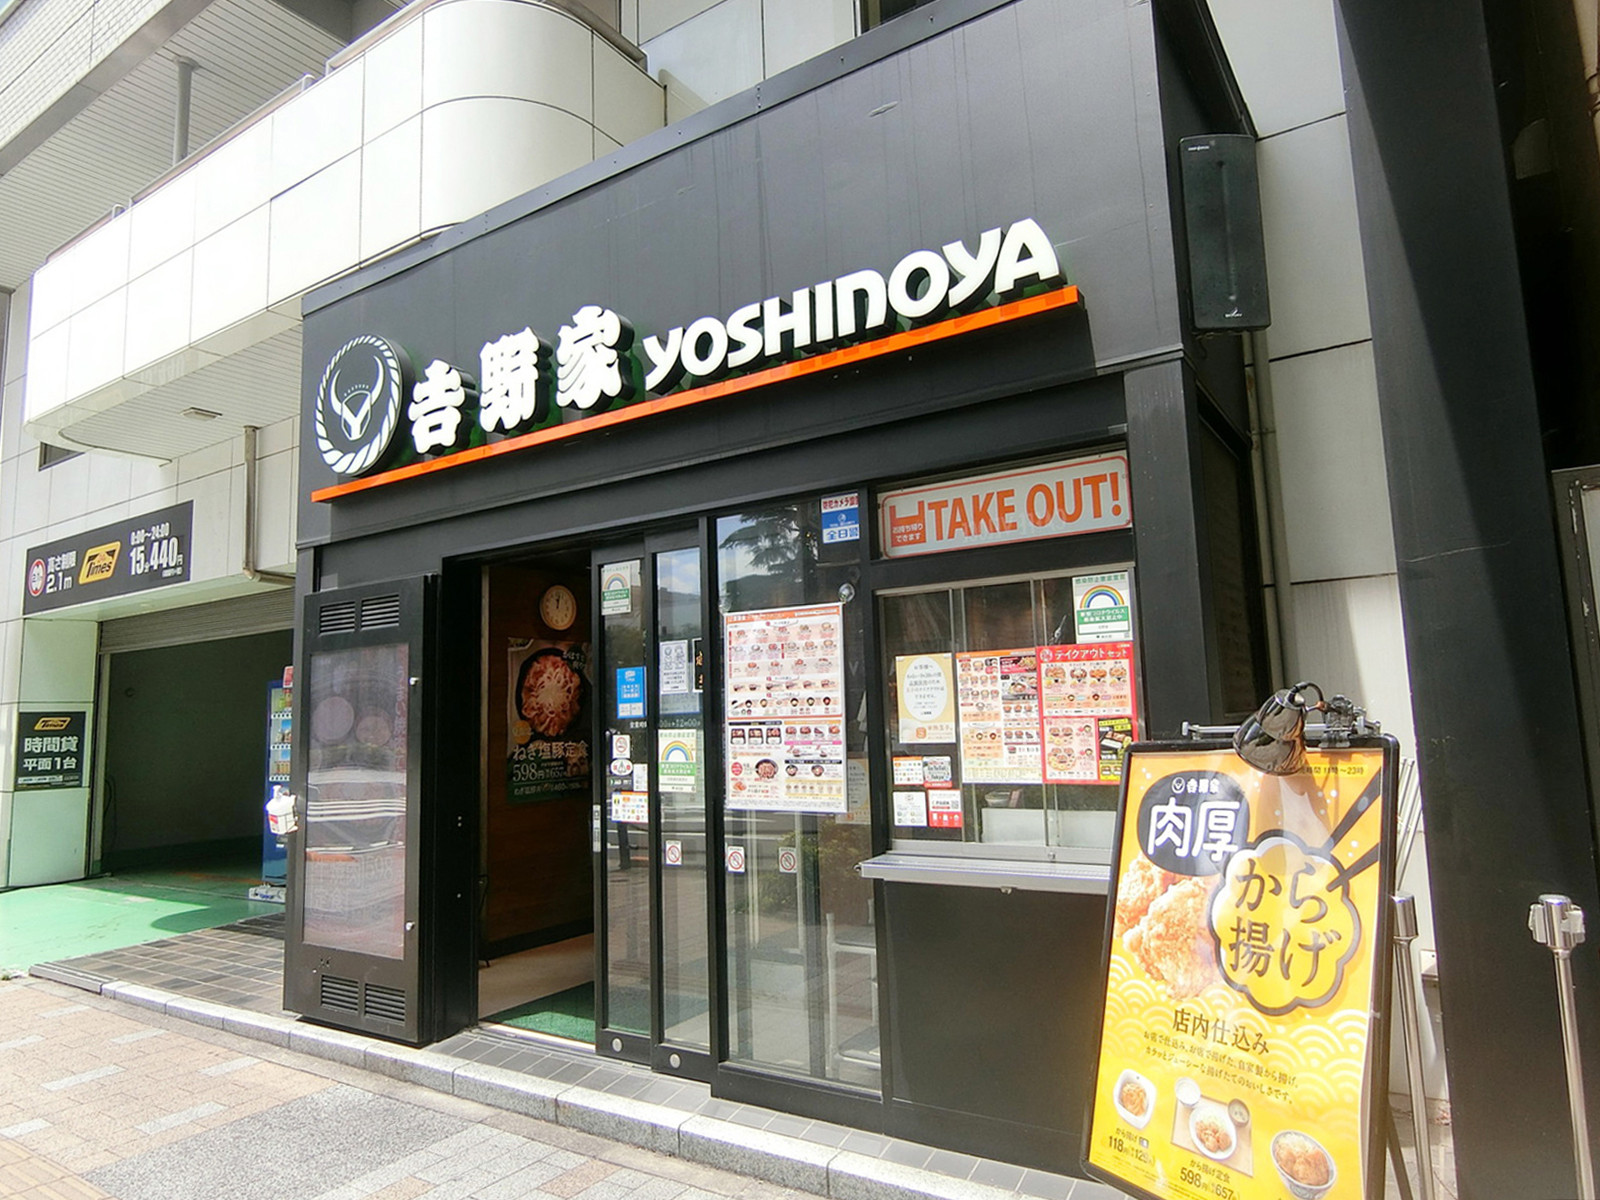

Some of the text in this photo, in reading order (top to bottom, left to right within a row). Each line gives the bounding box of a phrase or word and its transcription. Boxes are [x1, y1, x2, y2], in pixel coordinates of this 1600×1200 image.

[642, 216, 1062, 394] YOSHINOYA
[406, 304, 627, 456] 吉野家
[927, 471, 1122, 541] TAKE OUT!
[895, 532, 921, 543] できます
[46, 571, 73, 594] 2.1m
[86, 560, 112, 579] Times
[23, 757, 77, 771] 平面1台
[24, 736, 79, 753] 時間貸
[1186, 777, 1220, 794] 吉野家
[1147, 796, 1241, 862] 肉厚
[1235, 858, 1328, 923] から
[1229, 916, 1342, 988] 揚げ
[1171, 1007, 1270, 1056] 店内仕込み
